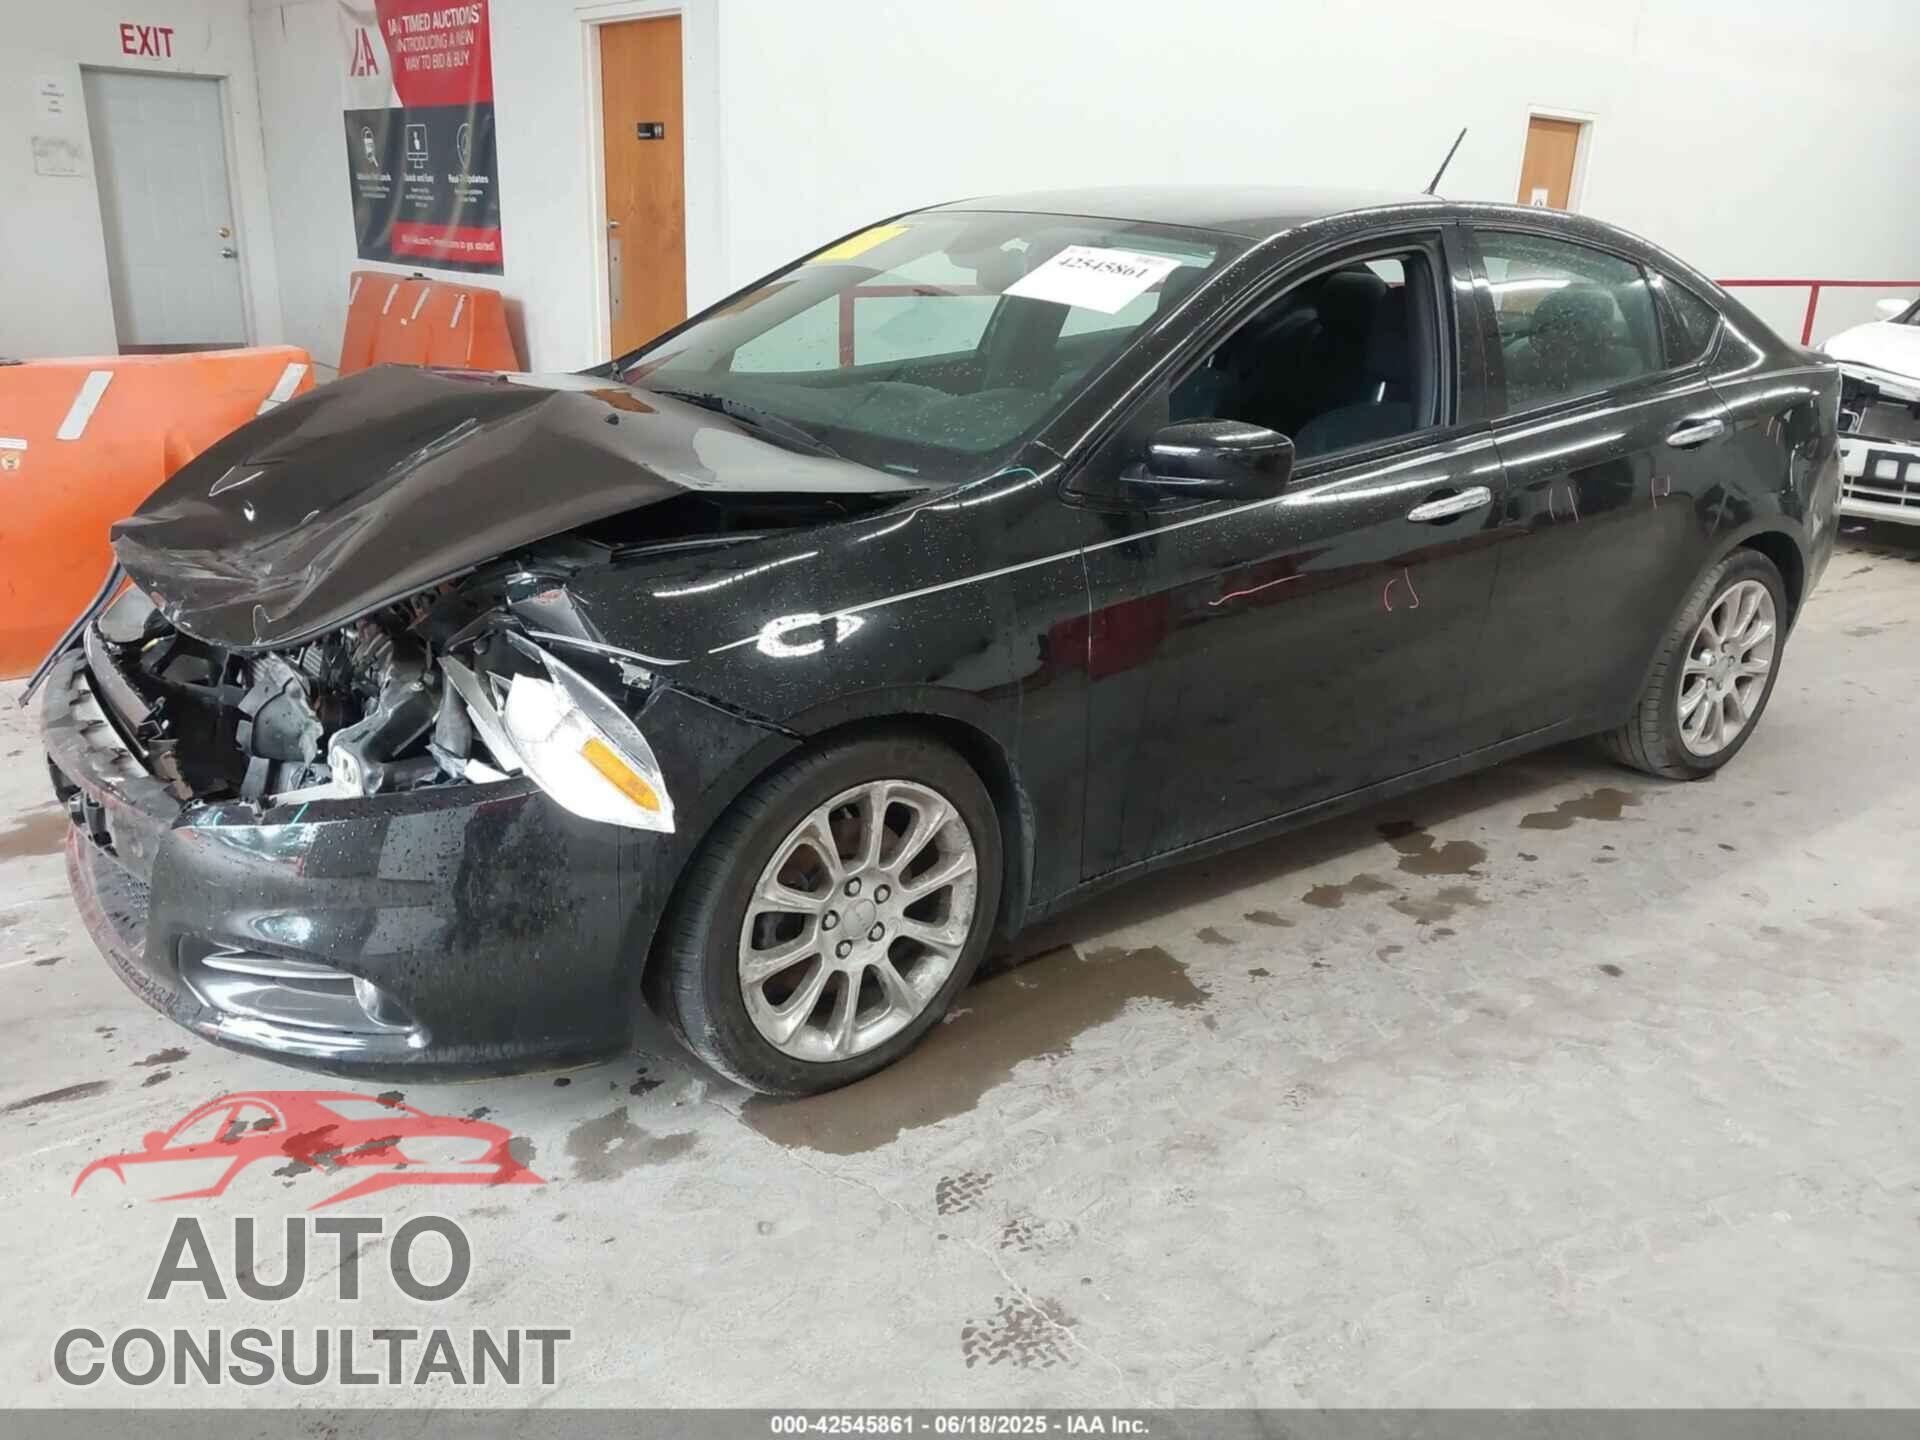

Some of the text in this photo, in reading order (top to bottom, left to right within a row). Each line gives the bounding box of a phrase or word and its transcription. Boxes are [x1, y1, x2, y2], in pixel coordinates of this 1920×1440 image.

[402, 13, 430, 33] TIMED
[119, 23, 174, 57] EXIT
[456, 29, 474, 46] NEW
[404, 55, 420, 71] WAY
[421, 54, 431, 70] TO
[432, 53, 445, 69] BID
[453, 50, 470, 67] BUY
[1058, 256, 1149, 278] 42545861
